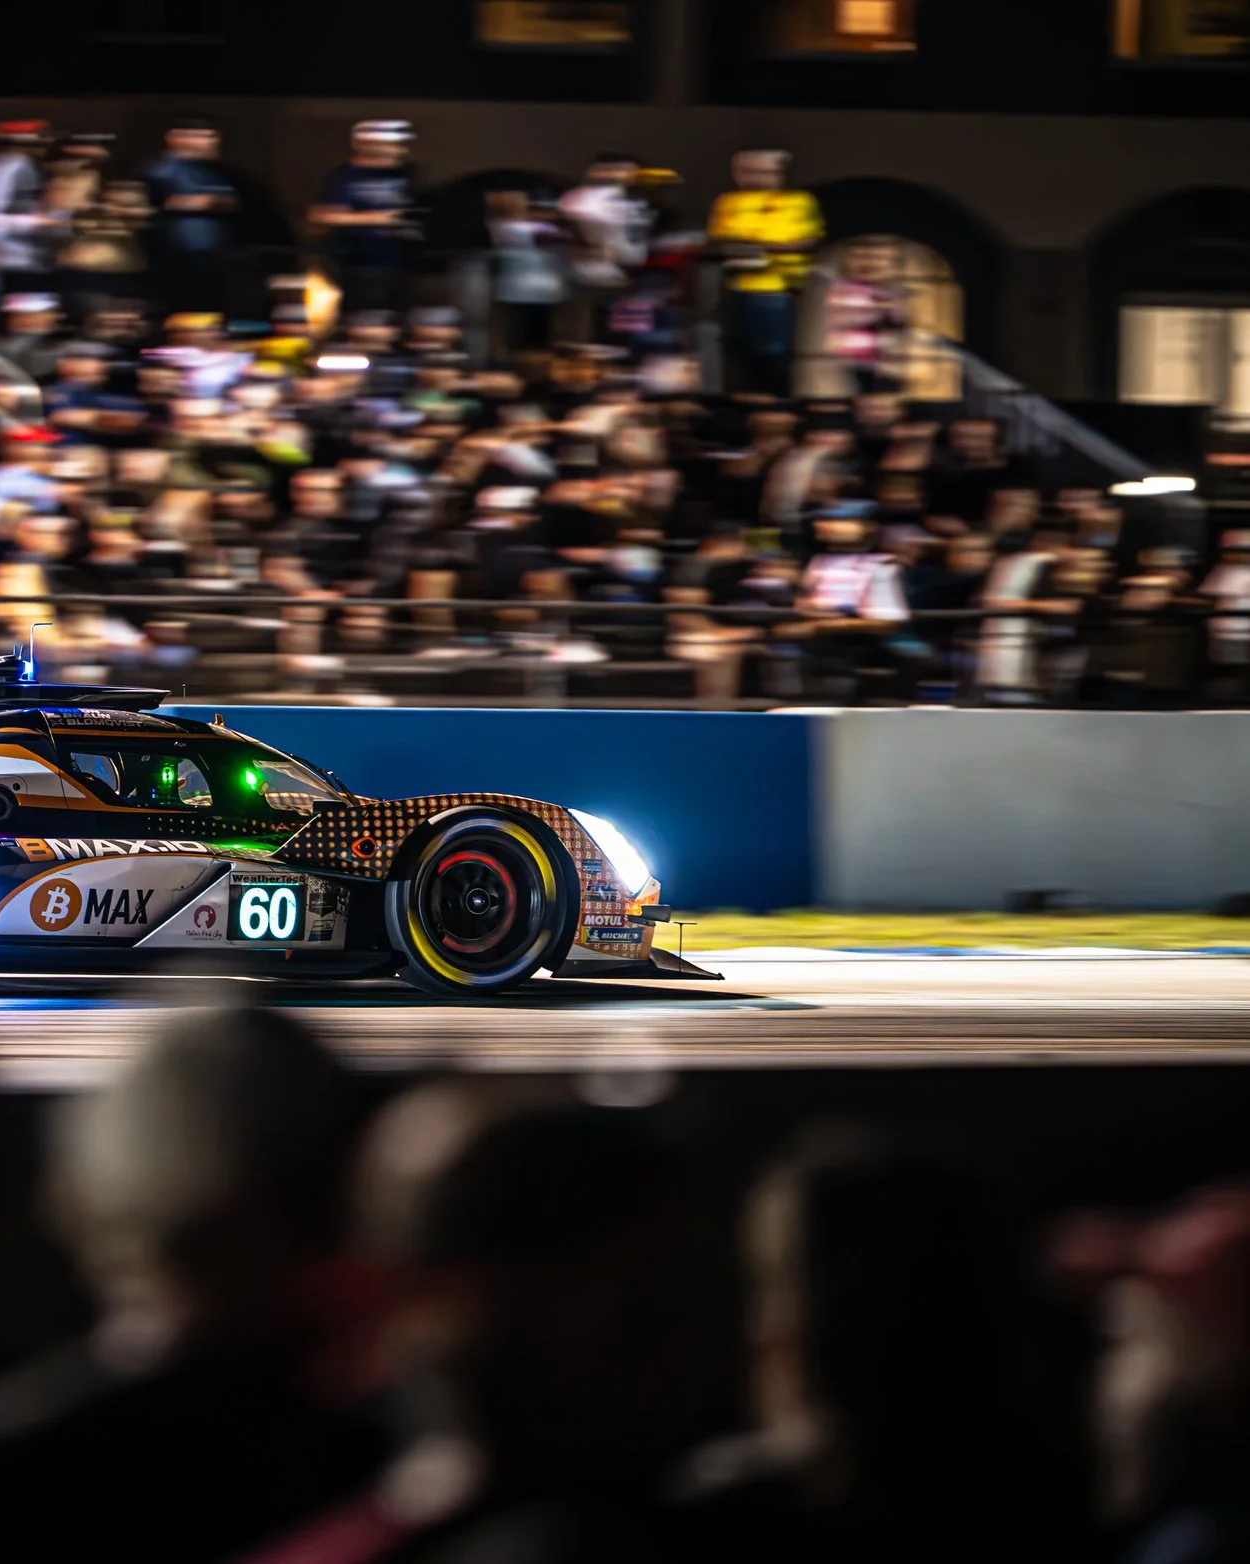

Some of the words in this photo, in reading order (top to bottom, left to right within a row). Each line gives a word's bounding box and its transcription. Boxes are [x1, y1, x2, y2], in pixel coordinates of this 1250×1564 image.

[83, 888, 155, 925] MAX
[239, 887, 297, 939] 60
[583, 915, 624, 926] MOTUL
